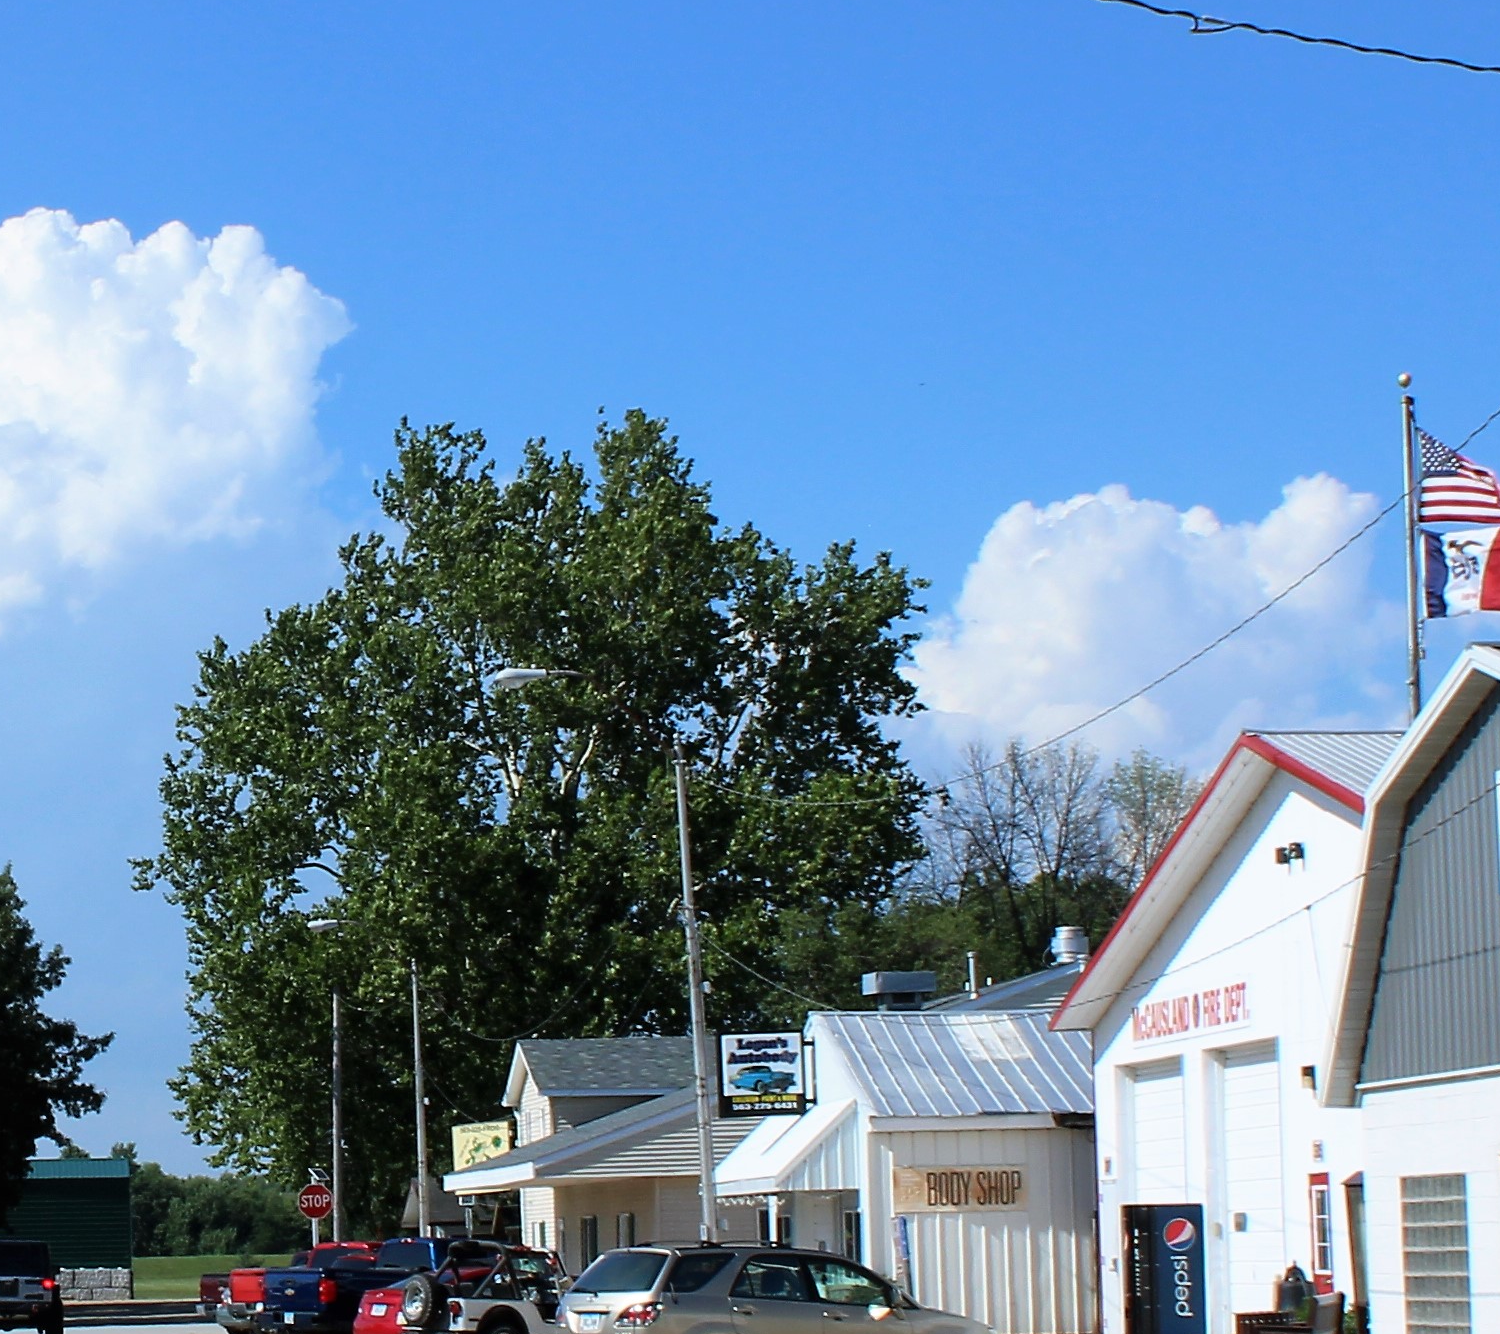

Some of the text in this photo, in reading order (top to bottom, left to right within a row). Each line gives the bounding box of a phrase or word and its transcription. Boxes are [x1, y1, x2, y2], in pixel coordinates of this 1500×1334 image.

[1203, 989, 1221, 1028] FIRE
[727, 1051, 799, 1065] Autobody
[300, 1194, 331, 1208] STOP
[926, 1170, 1021, 1207] BODY SHOP
[1170, 1255, 1193, 1317] pepsi
